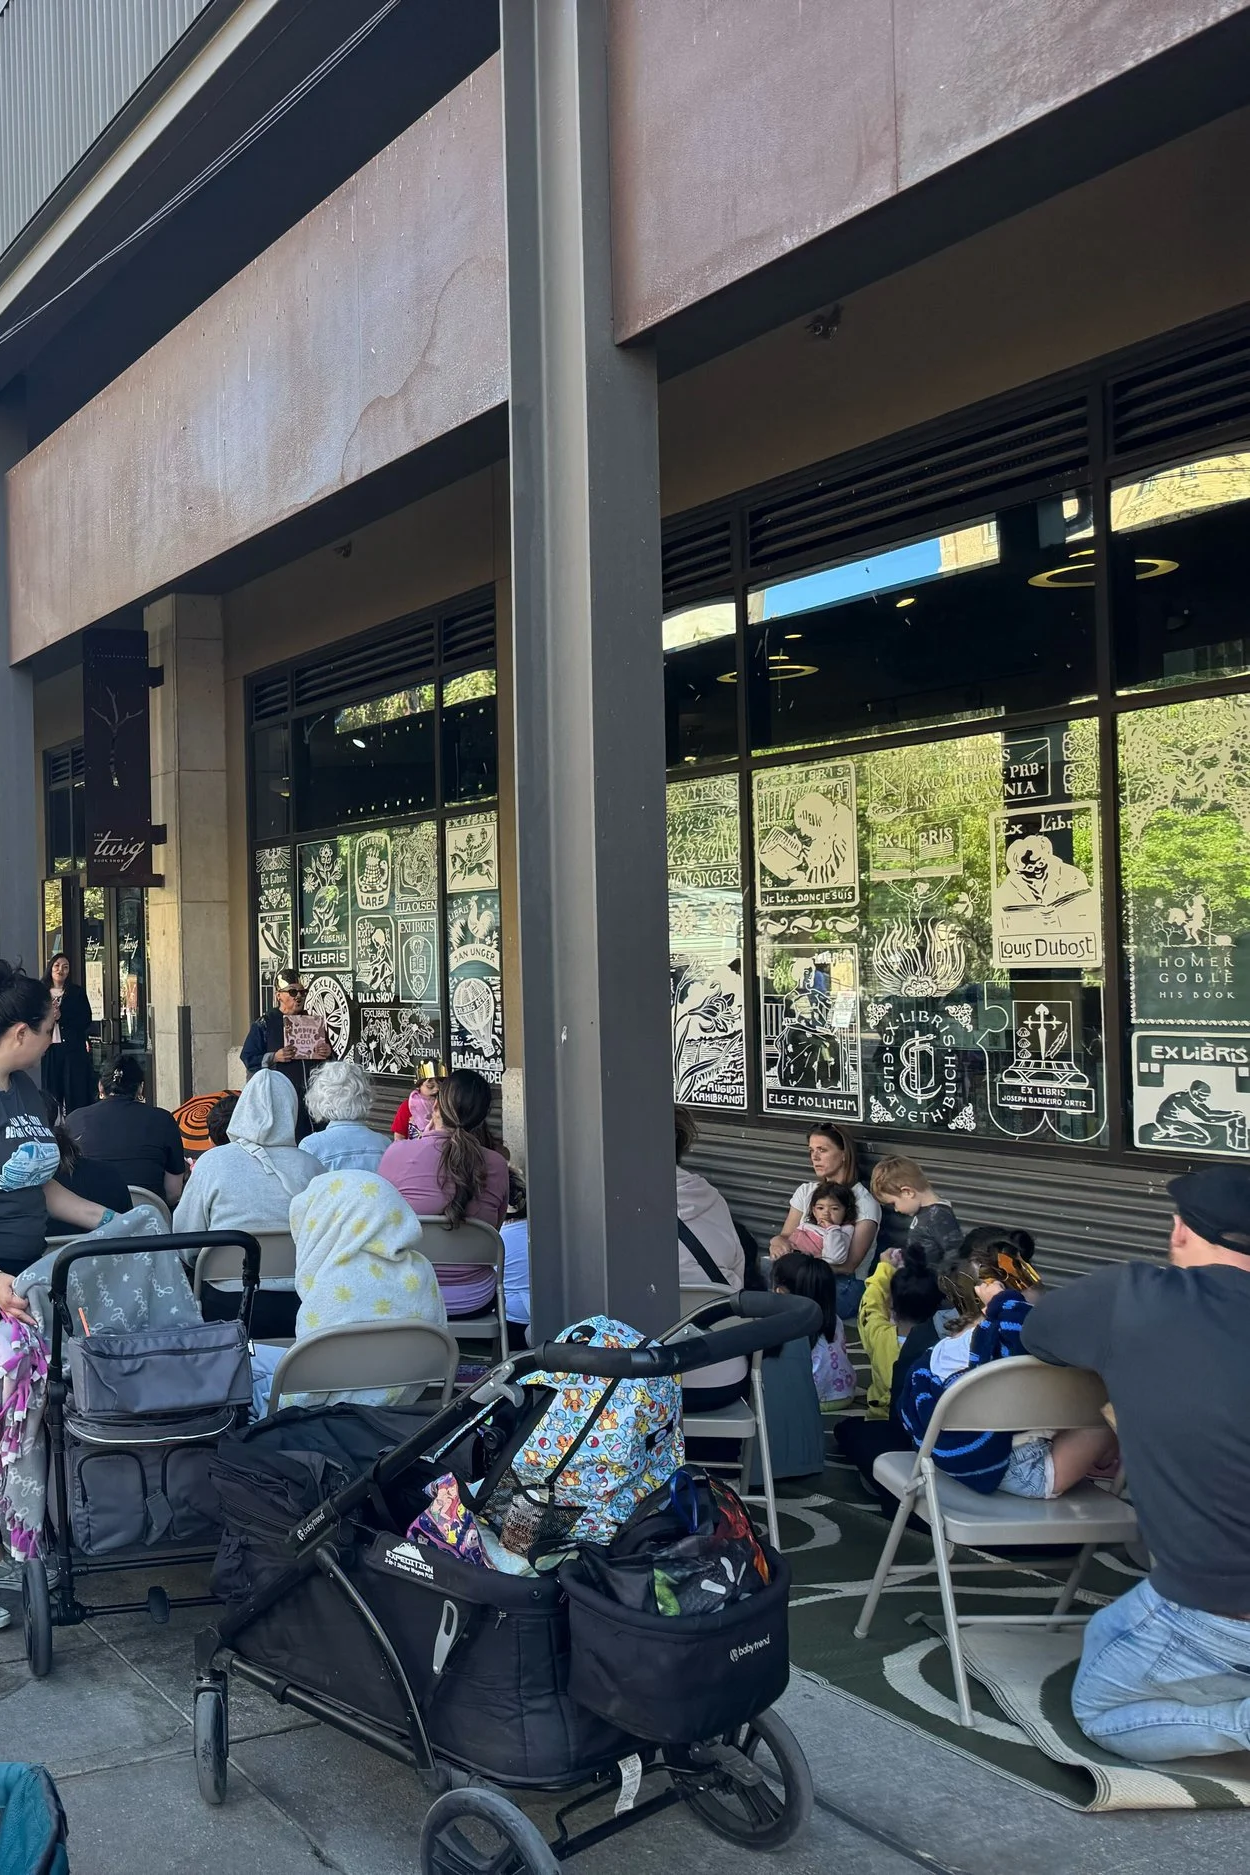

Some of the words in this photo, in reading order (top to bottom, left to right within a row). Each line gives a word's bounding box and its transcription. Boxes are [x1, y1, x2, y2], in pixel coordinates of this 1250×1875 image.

[1000, 819, 1023, 837] Ex
[94, 830, 145, 872] twig
[361, 895, 384, 907] LARS
[395, 902, 411, 913] ELLA
[412, 901, 437, 912] OLSEN
[453, 897, 463, 908] EX
[448, 904, 469, 922] LIBRIS
[300, 926, 319, 936] MARIA
[400, 920, 435, 934] EXLIBRIS
[320, 934, 347, 944] EUGENIA
[1036, 936, 1094, 958] Dubost
[453, 951, 470, 964] JAN
[471, 948, 496, 963] UNGER
[1159, 956, 1235, 968] HOMER
[1159, 972, 1234, 984] GOBLE
[314, 978, 349, 1015] EXLIBRIS
[358, 992, 375, 1003] ULLA
[376, 991, 396, 1002] SKOV
[1159, 991, 1184, 999] HIS
[1193, 991, 1236, 999] BOOK
[363, 1009, 391, 1018] EXLIBRIS
[1151, 1046, 1178, 1060] EX
[1183, 1045, 1249, 1064] LIBRIS
[707, 1082, 745, 1094] AUGUSTE
[1021, 1086, 1033, 1095] EX
[1037, 1087, 1067, 1097] LIBRIS
[768, 1093, 795, 1105] ELSE
[798, 1096, 857, 1112] MOLLHEIM
[1002, 1095, 1027, 1104] JOSEPH
[1029, 1096, 1063, 1106] BARREIRO
[1064, 1099, 1087, 1108] ORTIZ
[386, 1549, 434, 1574] EXPEDITION
